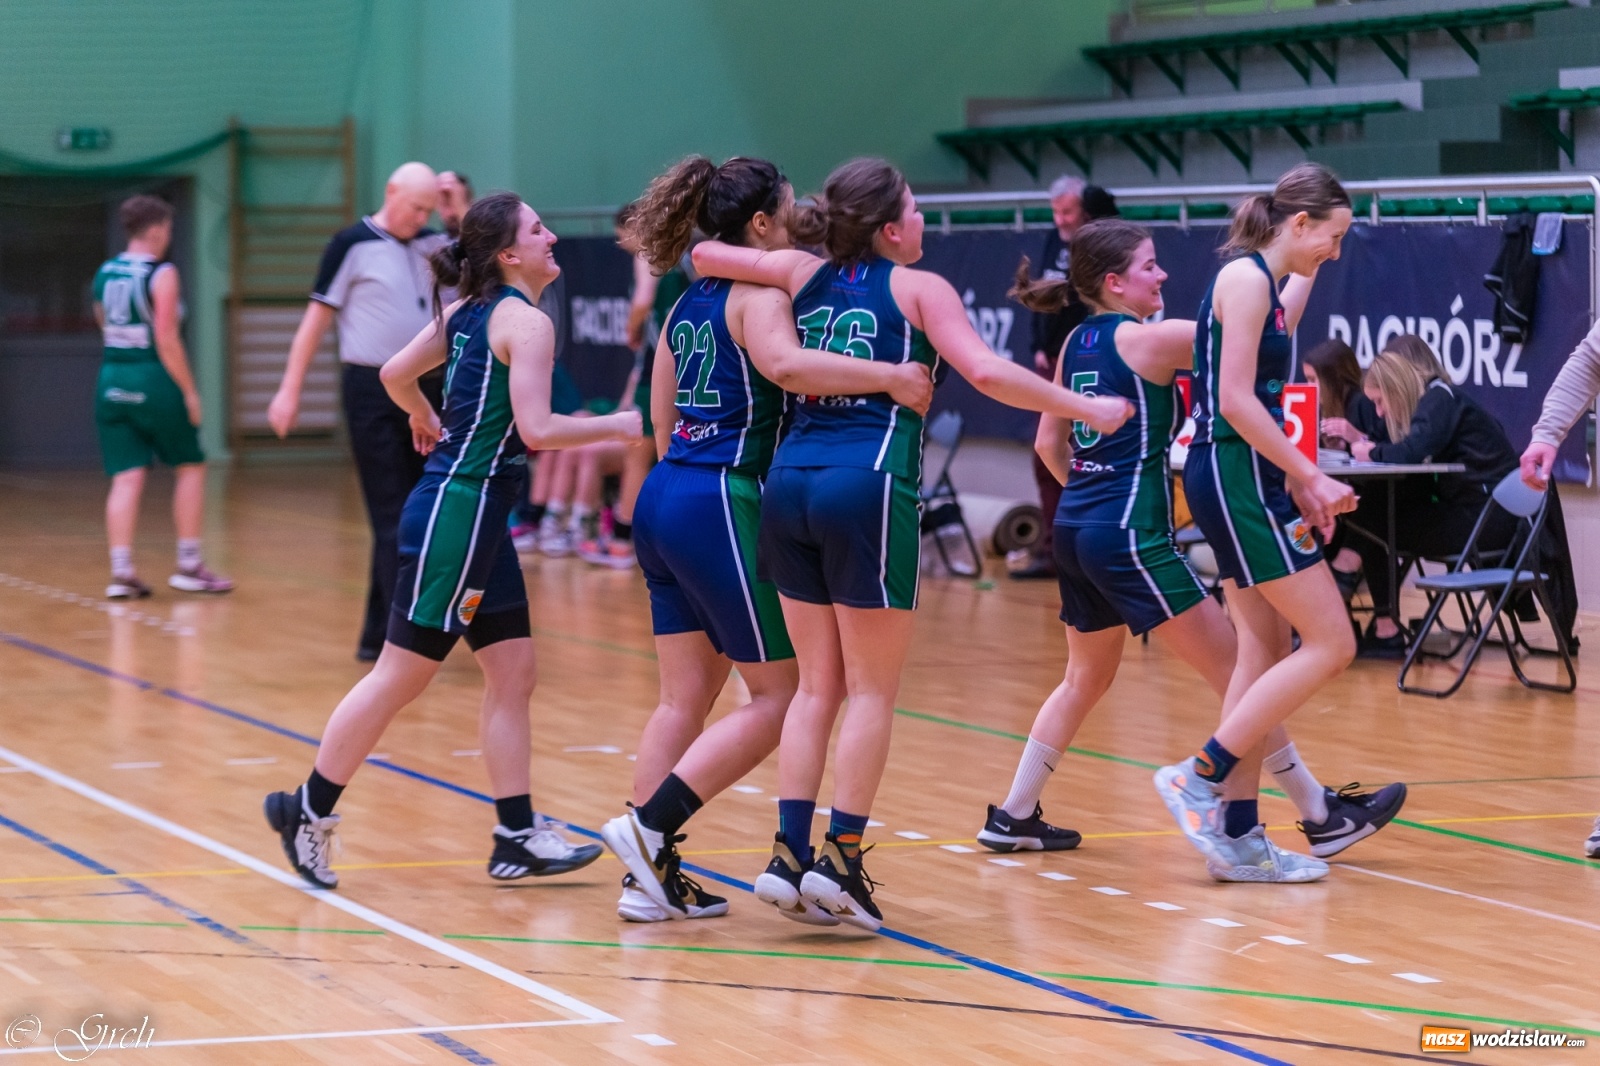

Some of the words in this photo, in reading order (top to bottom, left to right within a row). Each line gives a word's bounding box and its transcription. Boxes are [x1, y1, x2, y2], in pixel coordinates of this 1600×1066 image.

[671, 320, 722, 408] 22
[1328, 293, 1528, 388] ABÓRZ
[1283, 392, 1307, 446] 5
